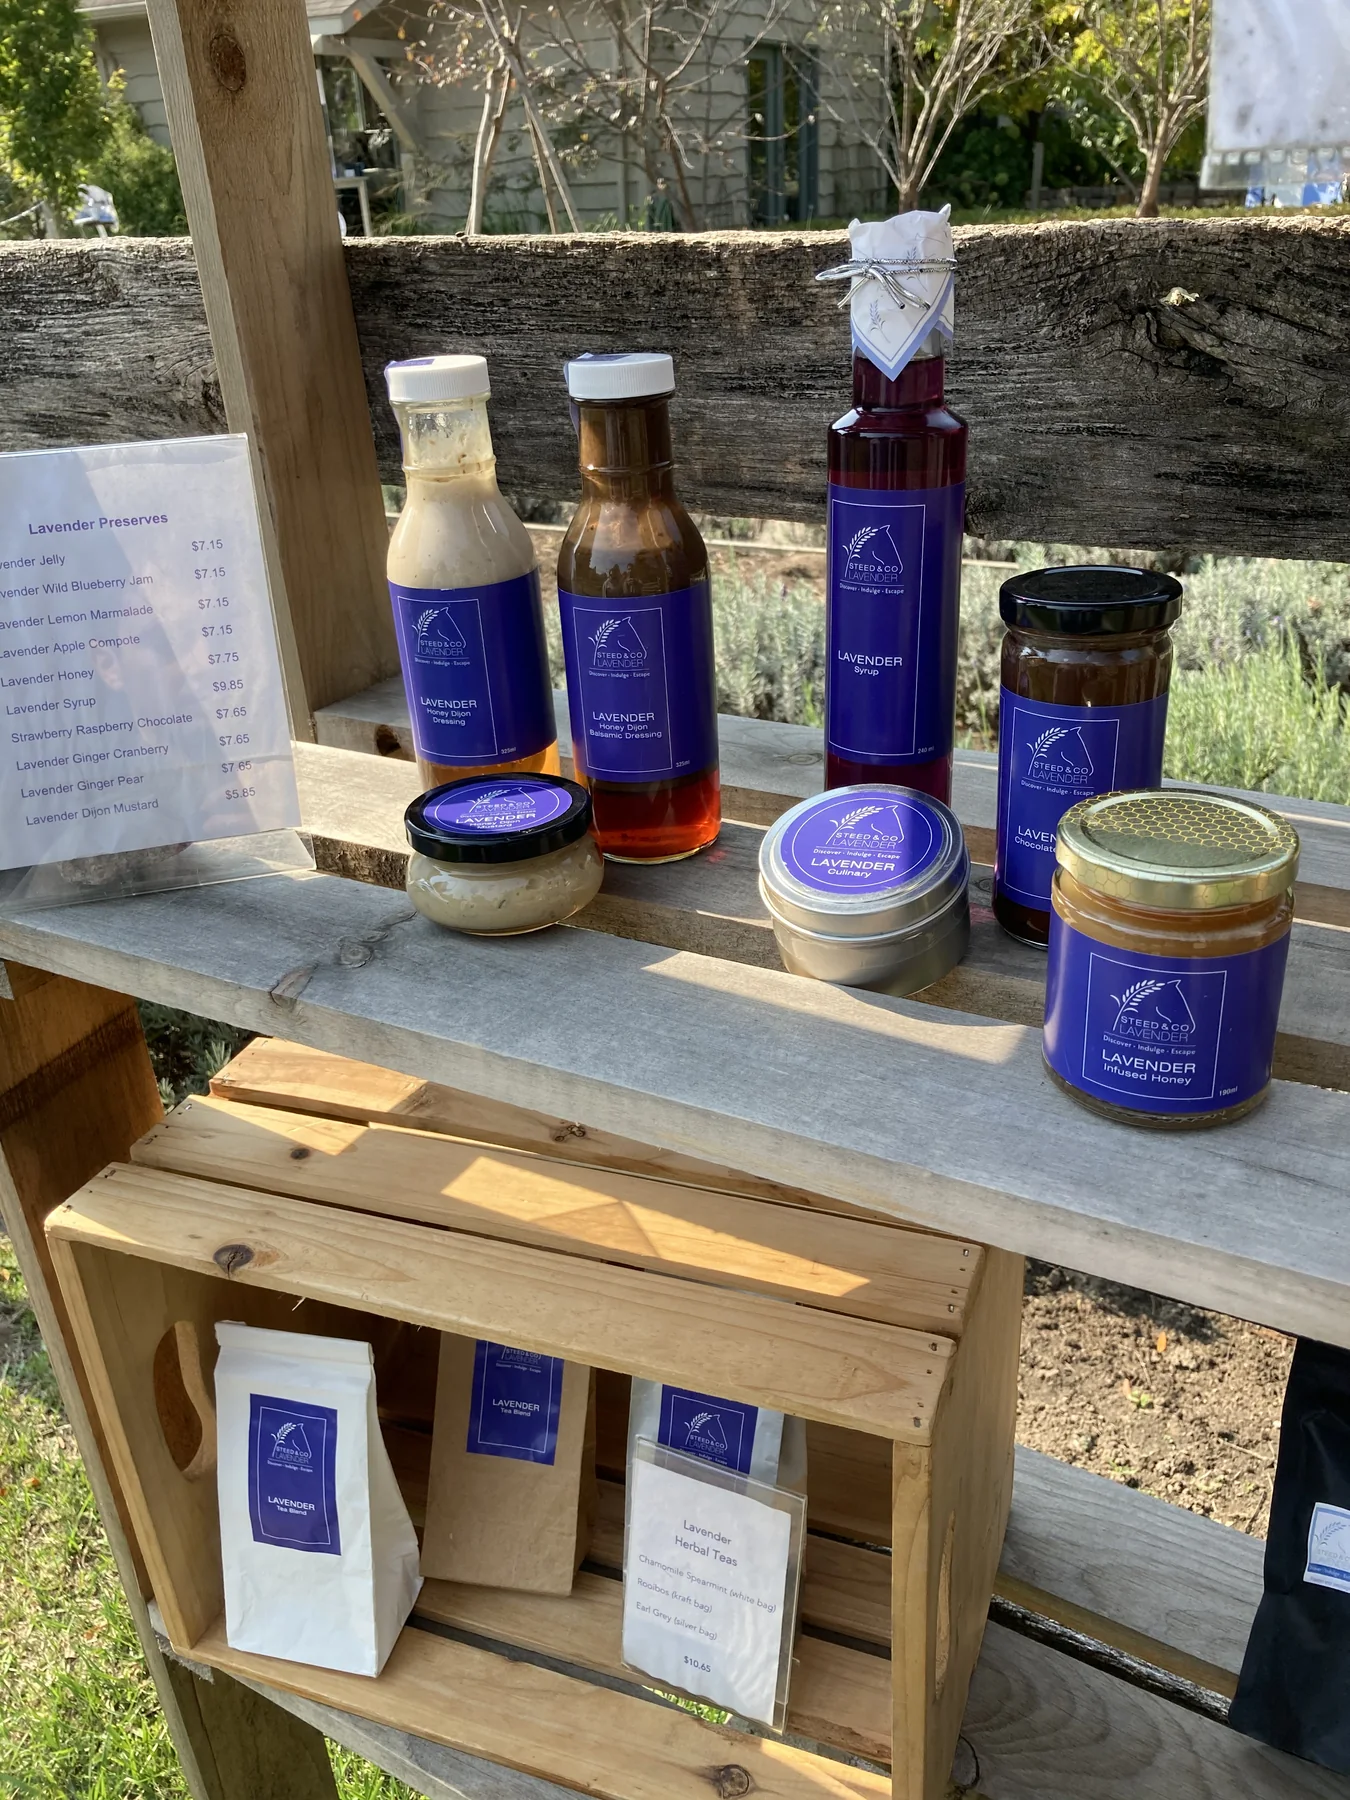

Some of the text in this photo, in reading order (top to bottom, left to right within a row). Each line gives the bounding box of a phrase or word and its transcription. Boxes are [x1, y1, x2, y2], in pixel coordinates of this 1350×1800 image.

[29, 512, 168, 535] Lavender Preserves
[40, 553, 65, 568] Jelly
[191, 539, 223, 552] $7.15
[849, 563, 875, 571] STEED
[42, 580, 68, 594] Wild
[72, 577, 126, 593] Blueberry
[129, 574, 154, 586] Jam
[194, 567, 226, 580] $7.15
[848, 570, 898, 582] LAVENDER
[861, 586, 880, 595] Indulge
[48, 611, 87, 626] Lemon
[90, 604, 154, 620] Marmalade
[198, 597, 229, 610] $7.15
[53, 639, 85, 654] Apple
[89, 634, 140, 652] Compote
[202, 624, 233, 638] $7.15
[421, 646, 463, 656] LAVENDER
[838, 650, 902, 666] LAVENDER
[1, 652, 239, 688] Lavender Honey $7.75
[598, 659, 643, 667] LAVENDER
[854, 666, 879, 676] Syrup
[6, 679, 244, 716] Lavender Syrup $9.85
[420, 697, 477, 709] LAVENDER
[427, 708, 471, 718] Honey Dijon
[592, 711, 655, 722] LAVENDER
[11, 706, 247, 743] Strawberry Raspberry Chocolate $7.65
[433, 717, 465, 727] Dressing
[600, 723, 624, 732] Honey
[590, 728, 662, 739] Balsamic Dressing
[16, 734, 250, 771] Lavender Ginger Cranberry $7.65
[1034, 761, 1063, 773] STEED
[20, 760, 252, 799] Lavender Ginger Pear $7.65
[1032, 769, 1088, 784] LAVENDER
[1021, 779, 1042, 791] Discover
[1047, 786, 1068, 795] Indulge
[26, 787, 256, 826] Lavender Dijon Mustard $5.85
[456, 814, 536, 824] LAVENDER
[835, 832, 871, 840] STEED
[832, 839, 896, 850] LAVENDER
[811, 858, 895, 872] LAVENDER
[828, 868, 872, 879] Culinary
[1121, 1015, 1159, 1030] STEED
[1171, 1023, 1189, 1032] CO
[1119, 1024, 1189, 1043] LAVENDER
[1103, 1035, 1196, 1056] Discover Indulge Escape
[1102, 1049, 1196, 1074] LAVENDER
[1104, 1063, 1192, 1086] Infused Honey
[1219, 1085, 1238, 1097] 190ml
[492, 1399, 540, 1411] LAVENDER
[513, 1409, 531, 1417] Blend
[690, 1435, 710, 1444] STEED
[276, 1446, 294, 1454] STEED
[268, 1496, 315, 1511] LAVENDER
[289, 1508, 307, 1516] Blend
[683, 1520, 732, 1545] Lavender
[675, 1535, 738, 1567] Herbal Teas
[639, 1554, 777, 1613] Chamomile Spearmint (white bag)
[637, 1577, 713, 1613] Rooibos (kraft bag)
[636, 1602, 717, 1641] Earl Grey (silver bag)
[684, 1655, 711, 1673] $10.65
